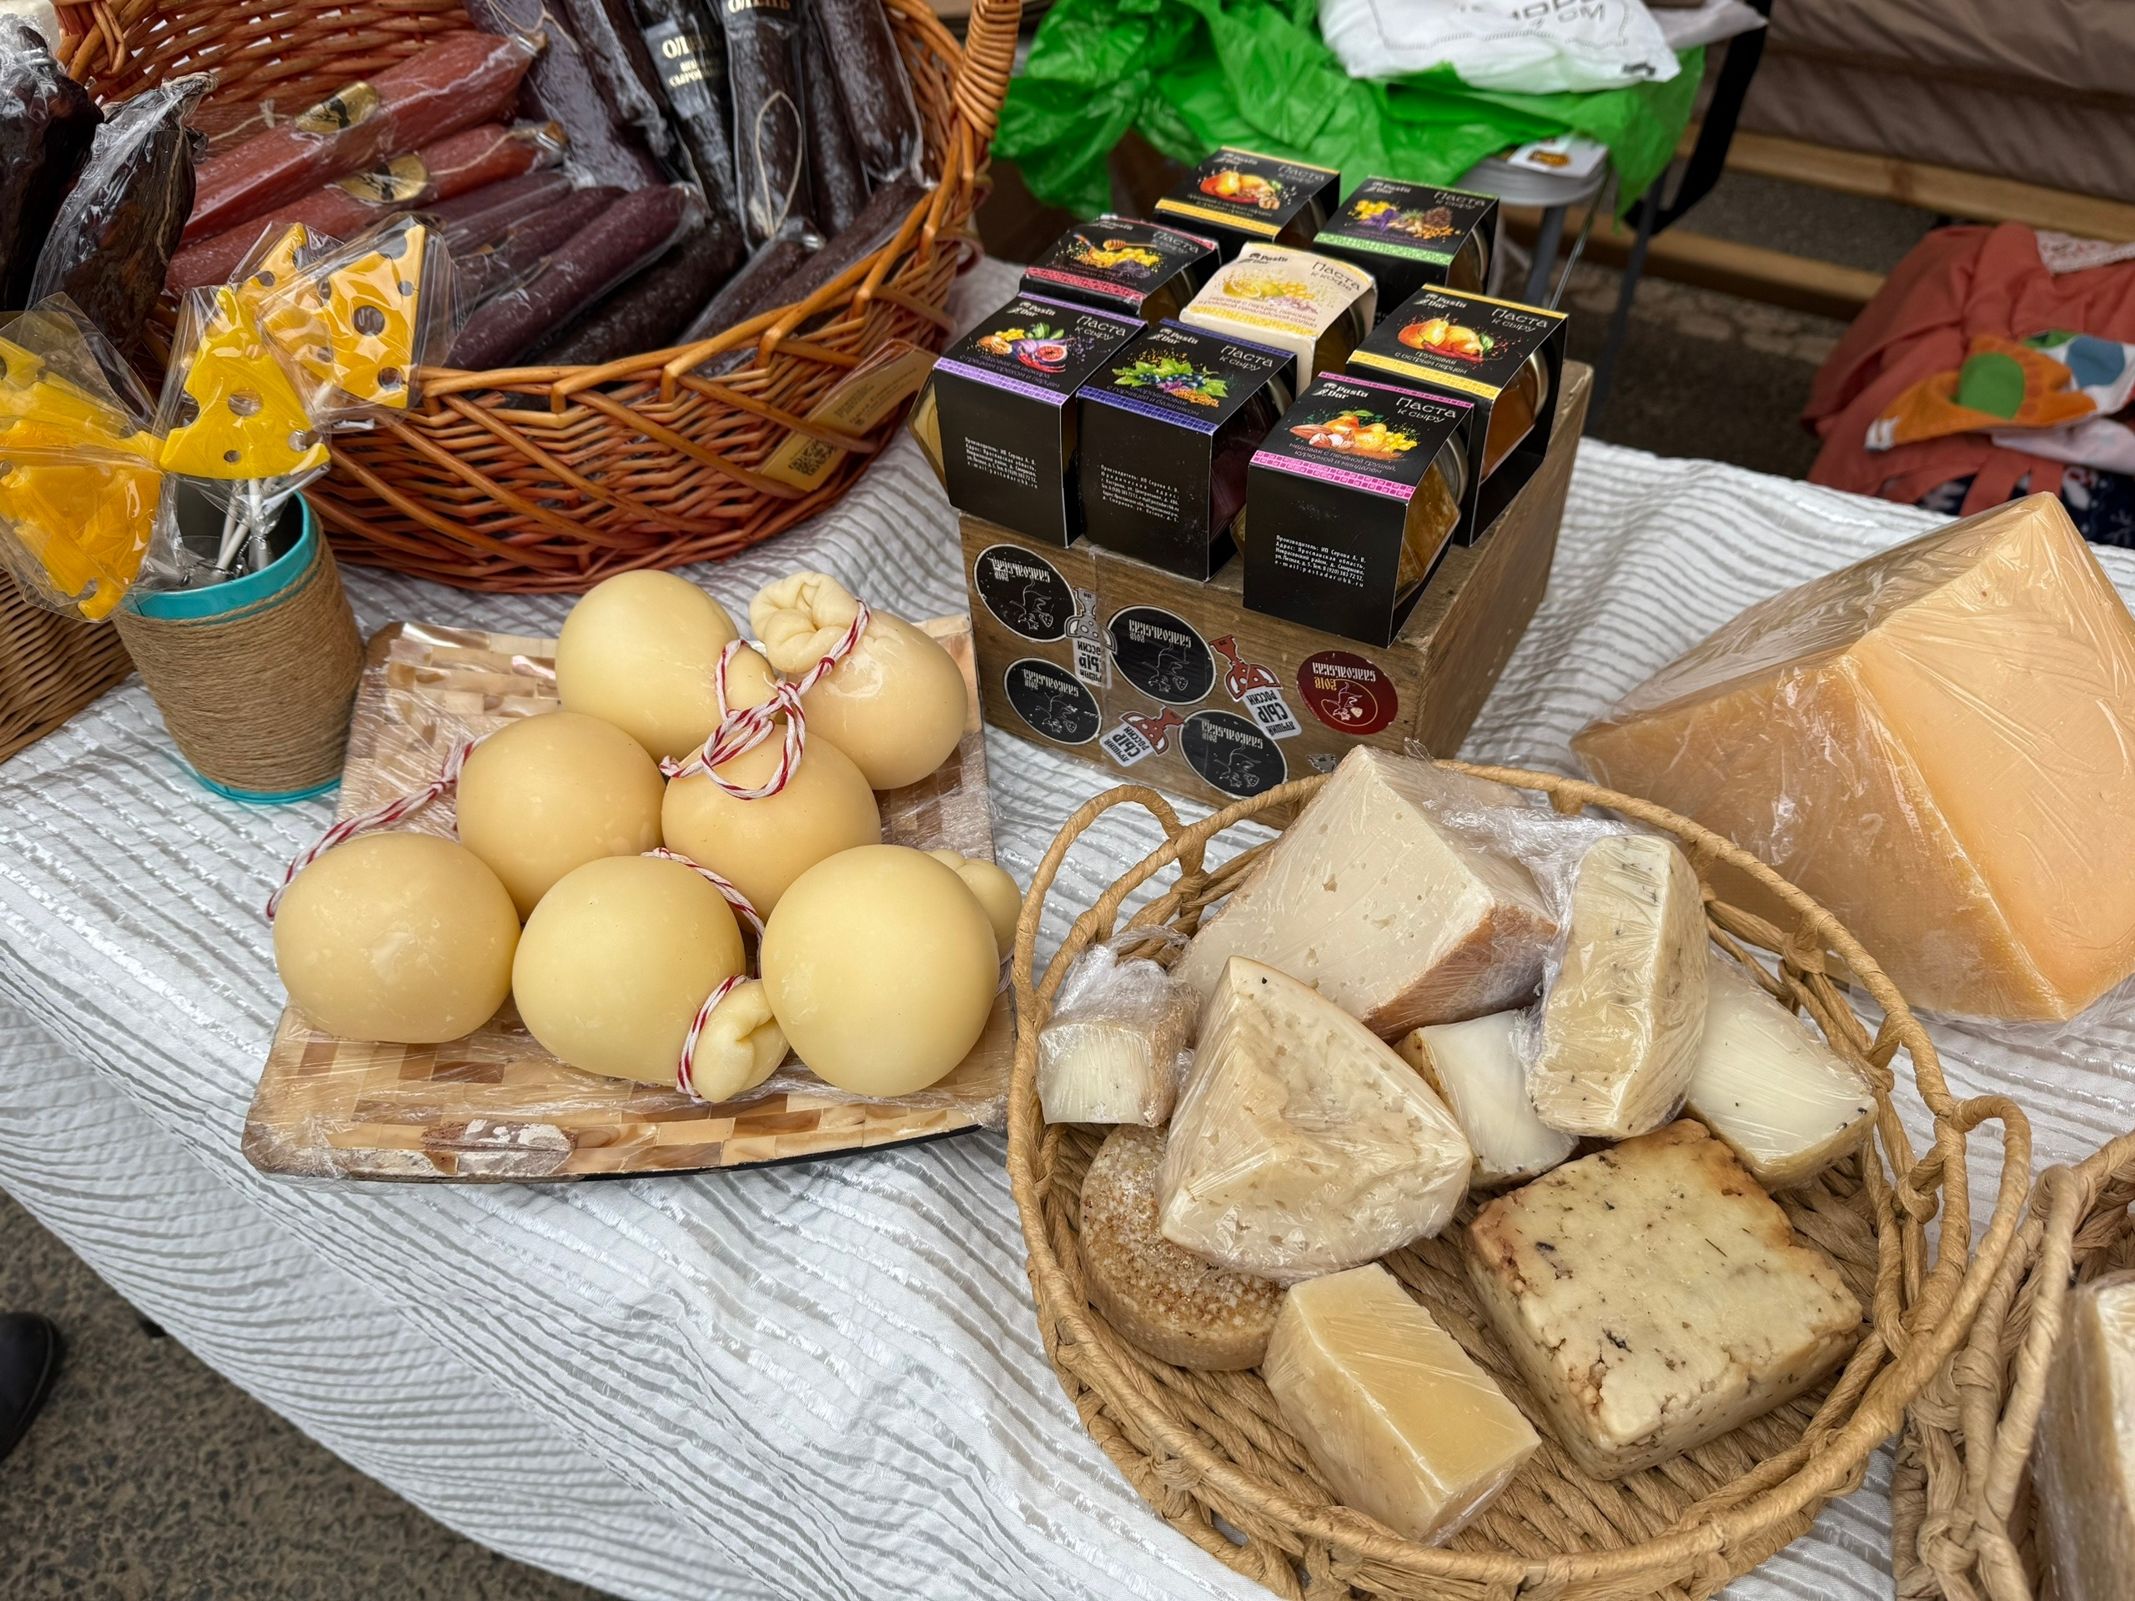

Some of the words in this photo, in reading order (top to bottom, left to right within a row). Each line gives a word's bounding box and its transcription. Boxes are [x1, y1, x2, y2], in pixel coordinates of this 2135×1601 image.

[1434, 191, 1485, 206] Паста
[1312, 261, 1361, 291] Паста
[1427, 299, 1448, 310] Dar
[1436, 295, 1467, 309] Pasta
[1020, 308, 1038, 318] Dar
[1030, 304, 1057, 317] Pasta
[1491, 308, 1548, 329] Паста
[1075, 315, 1127, 338] Паста
[1502, 321, 1538, 333] сыру
[1083, 328, 1115, 341] сыру
[1160, 335, 1180, 345] Dar
[1170, 331, 1200, 345] Pasta
[1220, 344, 1273, 368] Паста
[1415, 351, 1457, 365] грушевая
[1228, 357, 1261, 371] сыру
[1329, 389, 1349, 400] Dar
[1338, 384, 1369, 399] Pasta
[1396, 397, 1457, 419] Паста
[1408, 410, 1447, 424] сыру
[1276, 534, 1319, 551] Производитель:
[1330, 549, 1350, 559] Серова
[1275, 541, 1296, 551] Адрес:
[1297, 547, 1336, 562] Ярославская
[1338, 558, 1366, 570] область,
[1326, 566, 1340, 575] (920)
[1246, 690, 1278, 706] РОССИИ
[1256, 702, 1289, 723] СЫР
[1265, 720, 1297, 736] ЛУЧШИЙ
[1112, 732, 1141, 758] СЫР
[1123, 726, 1150, 751] РОССИИ
[1103, 738, 1130, 763] ЛУЧШИЙ
